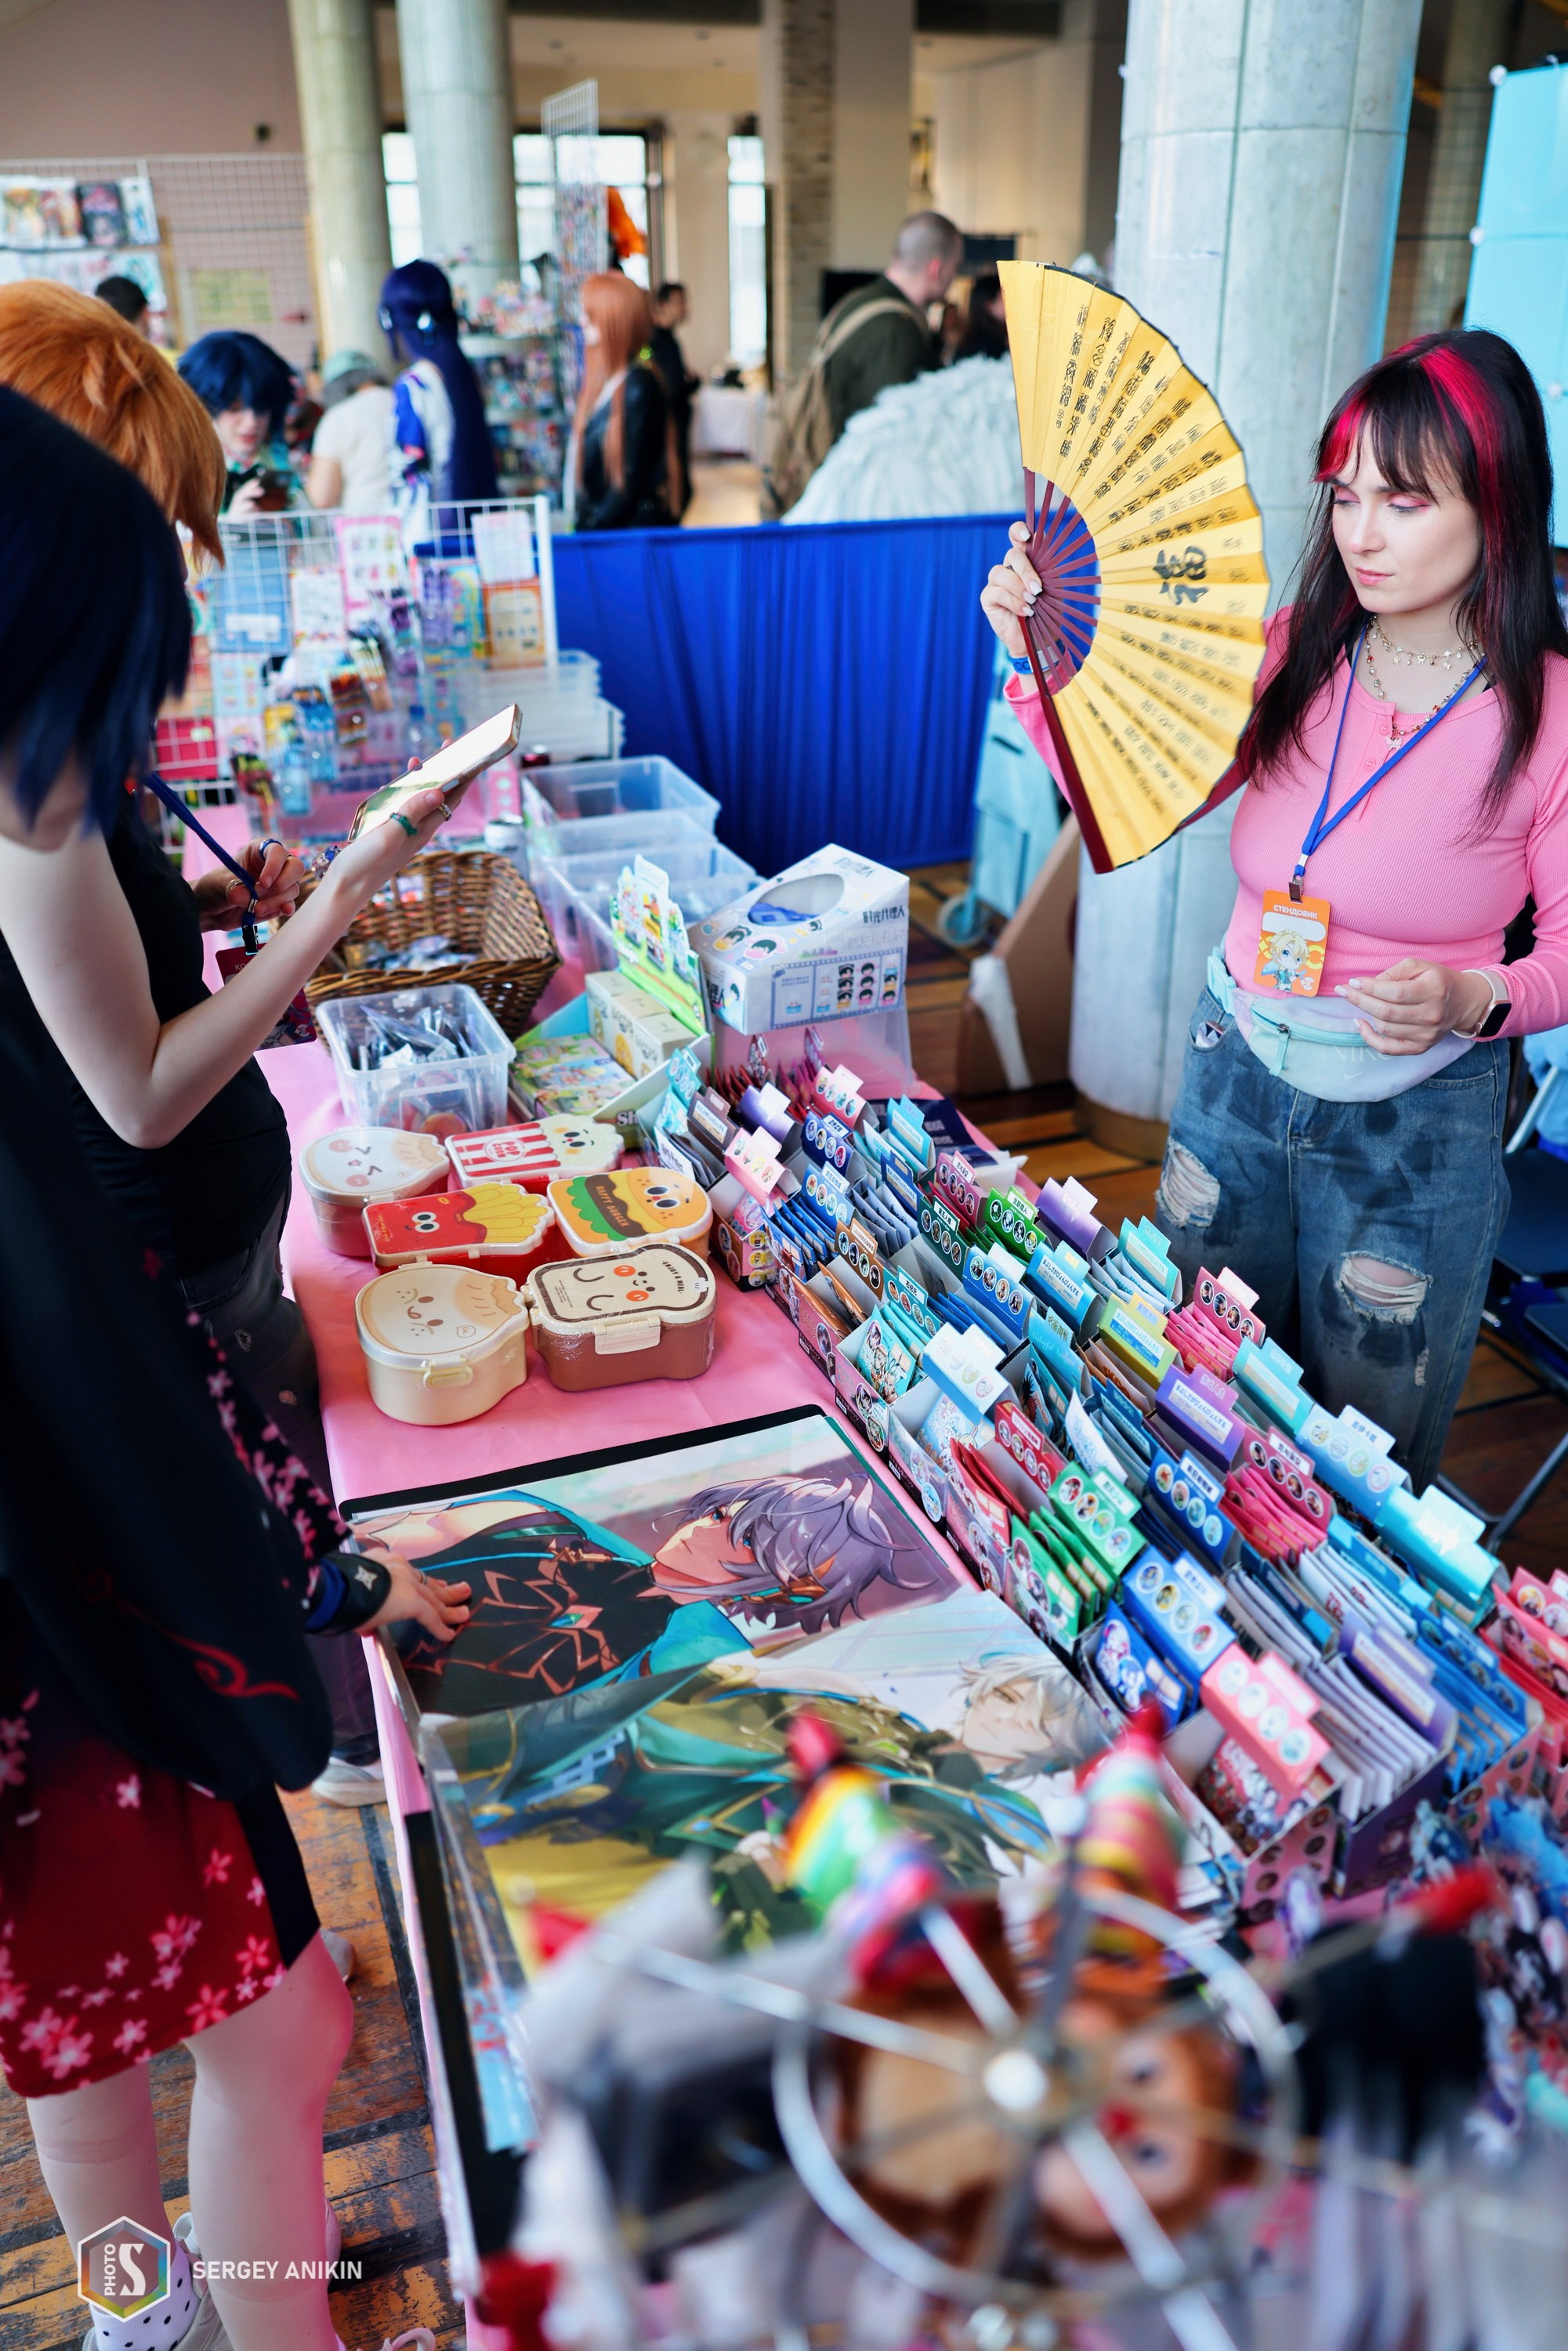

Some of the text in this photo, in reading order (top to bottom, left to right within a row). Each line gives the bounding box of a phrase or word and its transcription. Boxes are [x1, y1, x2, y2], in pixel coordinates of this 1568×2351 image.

[863, 905, 905, 924] 时光代理人
[1273, 904, 1318, 919] СТЕНДОВИК
[503, 1141, 520, 1156] POP
[596, 1186, 629, 1226] HAPPY BURGER
[939, 1207, 951, 1225] 第五人格
[662, 1261, 679, 1275] ENJOY
[905, 1280, 918, 1296] 石纪元
[1033, 1331, 1054, 1353] Colorful
